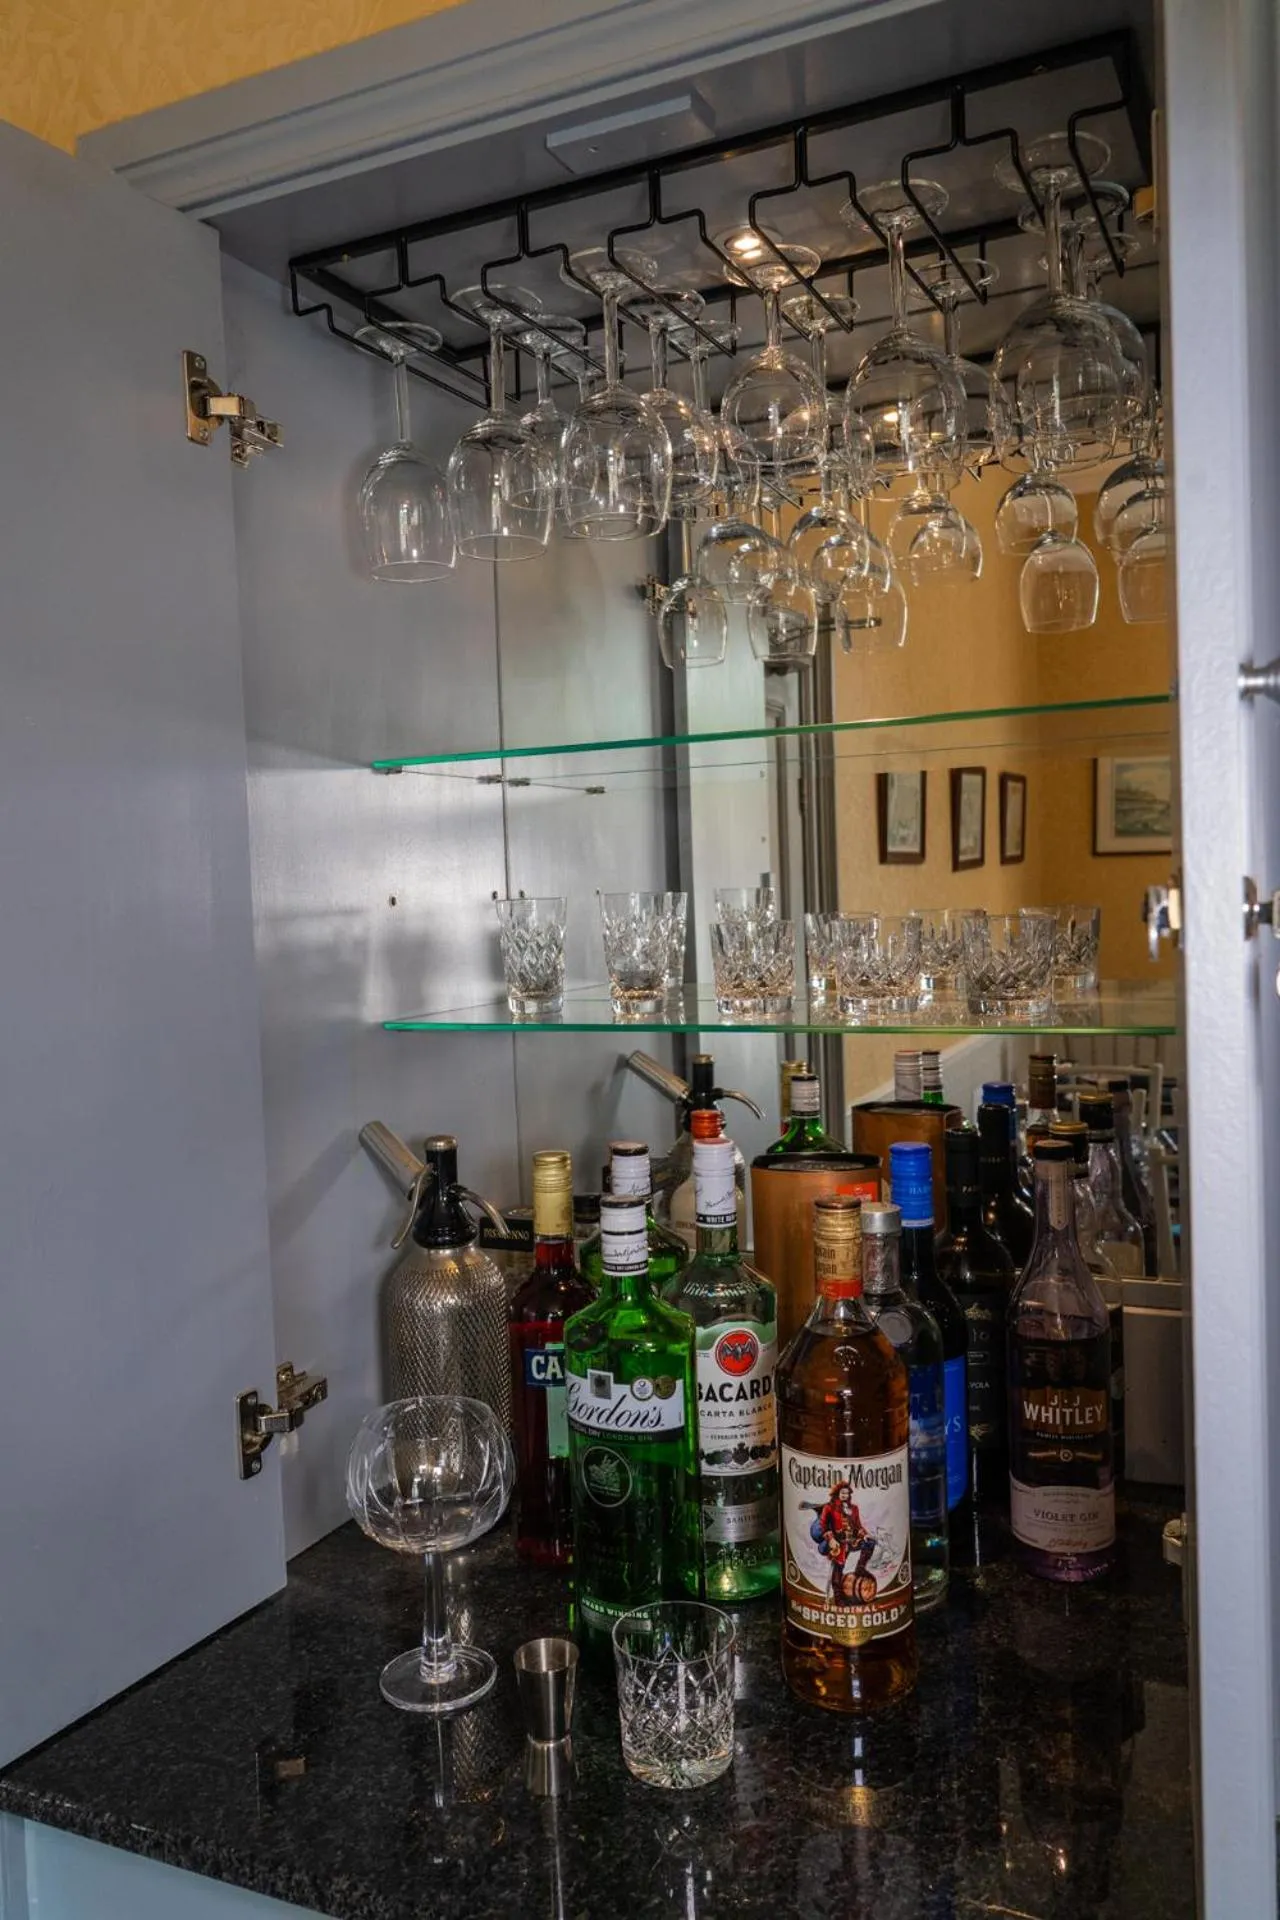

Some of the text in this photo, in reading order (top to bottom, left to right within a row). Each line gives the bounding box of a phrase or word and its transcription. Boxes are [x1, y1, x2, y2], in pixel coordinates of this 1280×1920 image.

[531, 1355, 564, 1380] CA
[1023, 1400, 1104, 1425] WHITLEY
[788, 1456, 903, 1491] Captain Morgan
[1033, 1508, 1099, 1522] VIOLET GIN
[801, 1609, 900, 1629] SPICED GOLD
[823, 1604, 877, 1613] ORIGINAL
